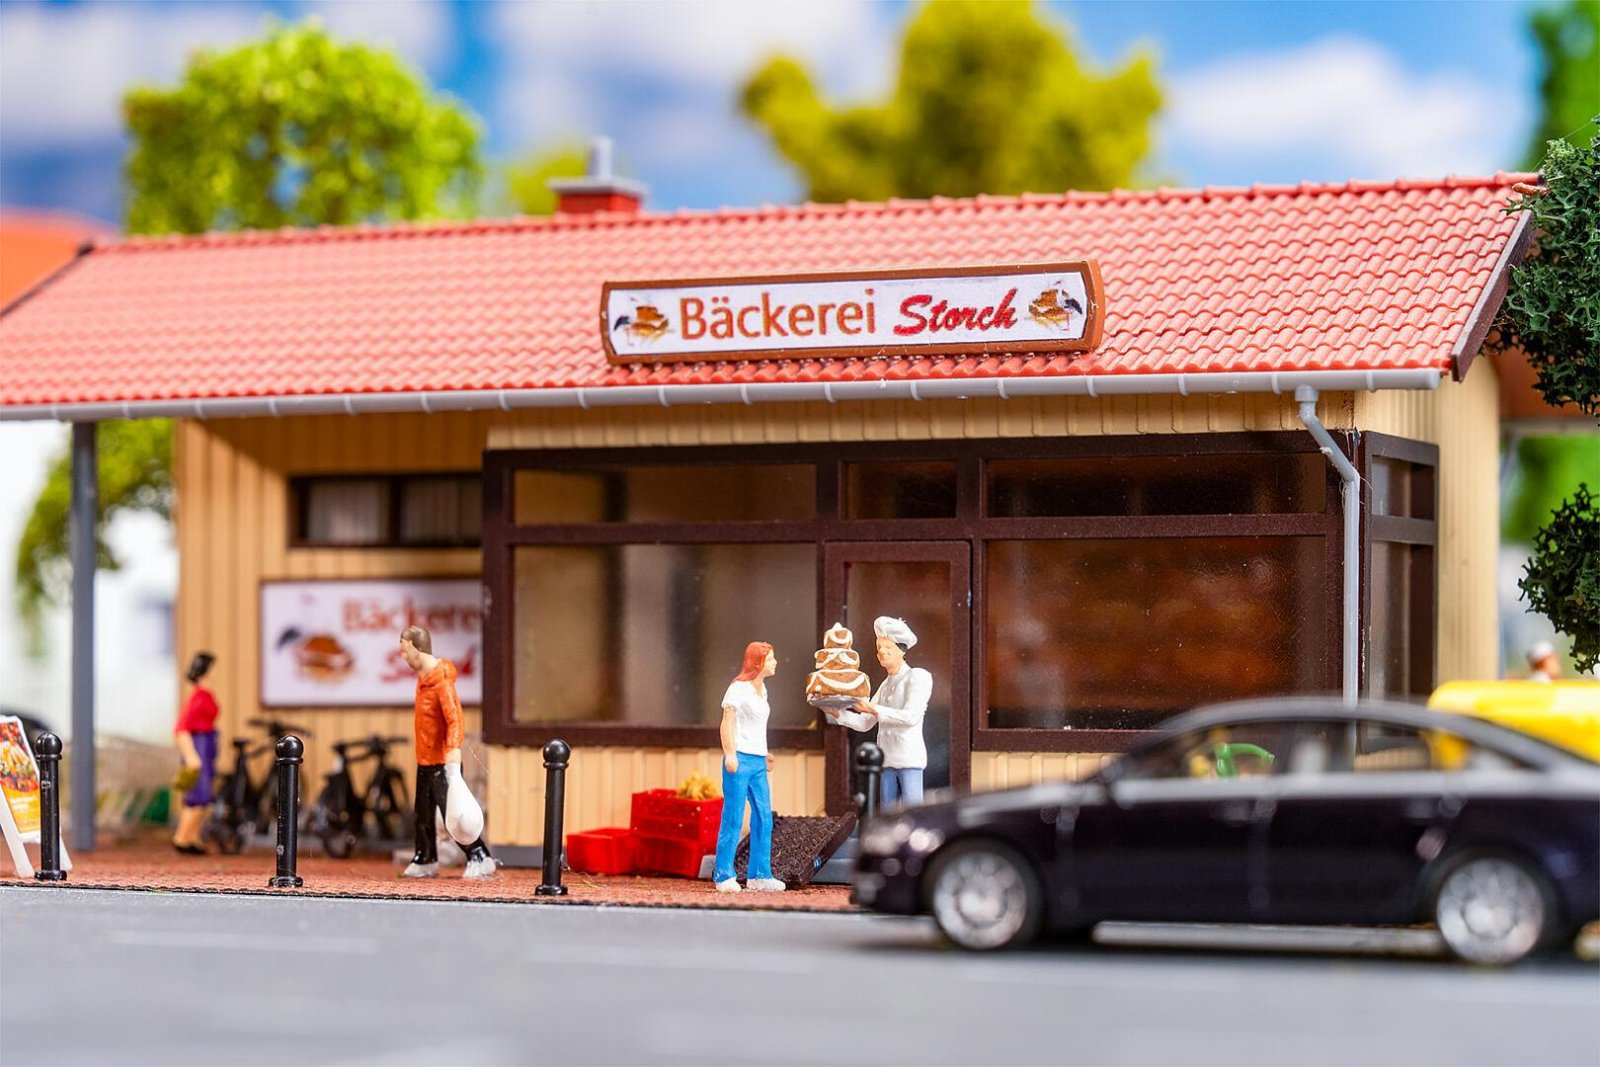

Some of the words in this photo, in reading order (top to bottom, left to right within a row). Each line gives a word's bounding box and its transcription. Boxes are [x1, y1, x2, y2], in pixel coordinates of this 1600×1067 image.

[679, 287, 876, 341] Bäckerei
[892, 287, 1019, 337] Storch
[342, 597, 482, 633] Bäckere
